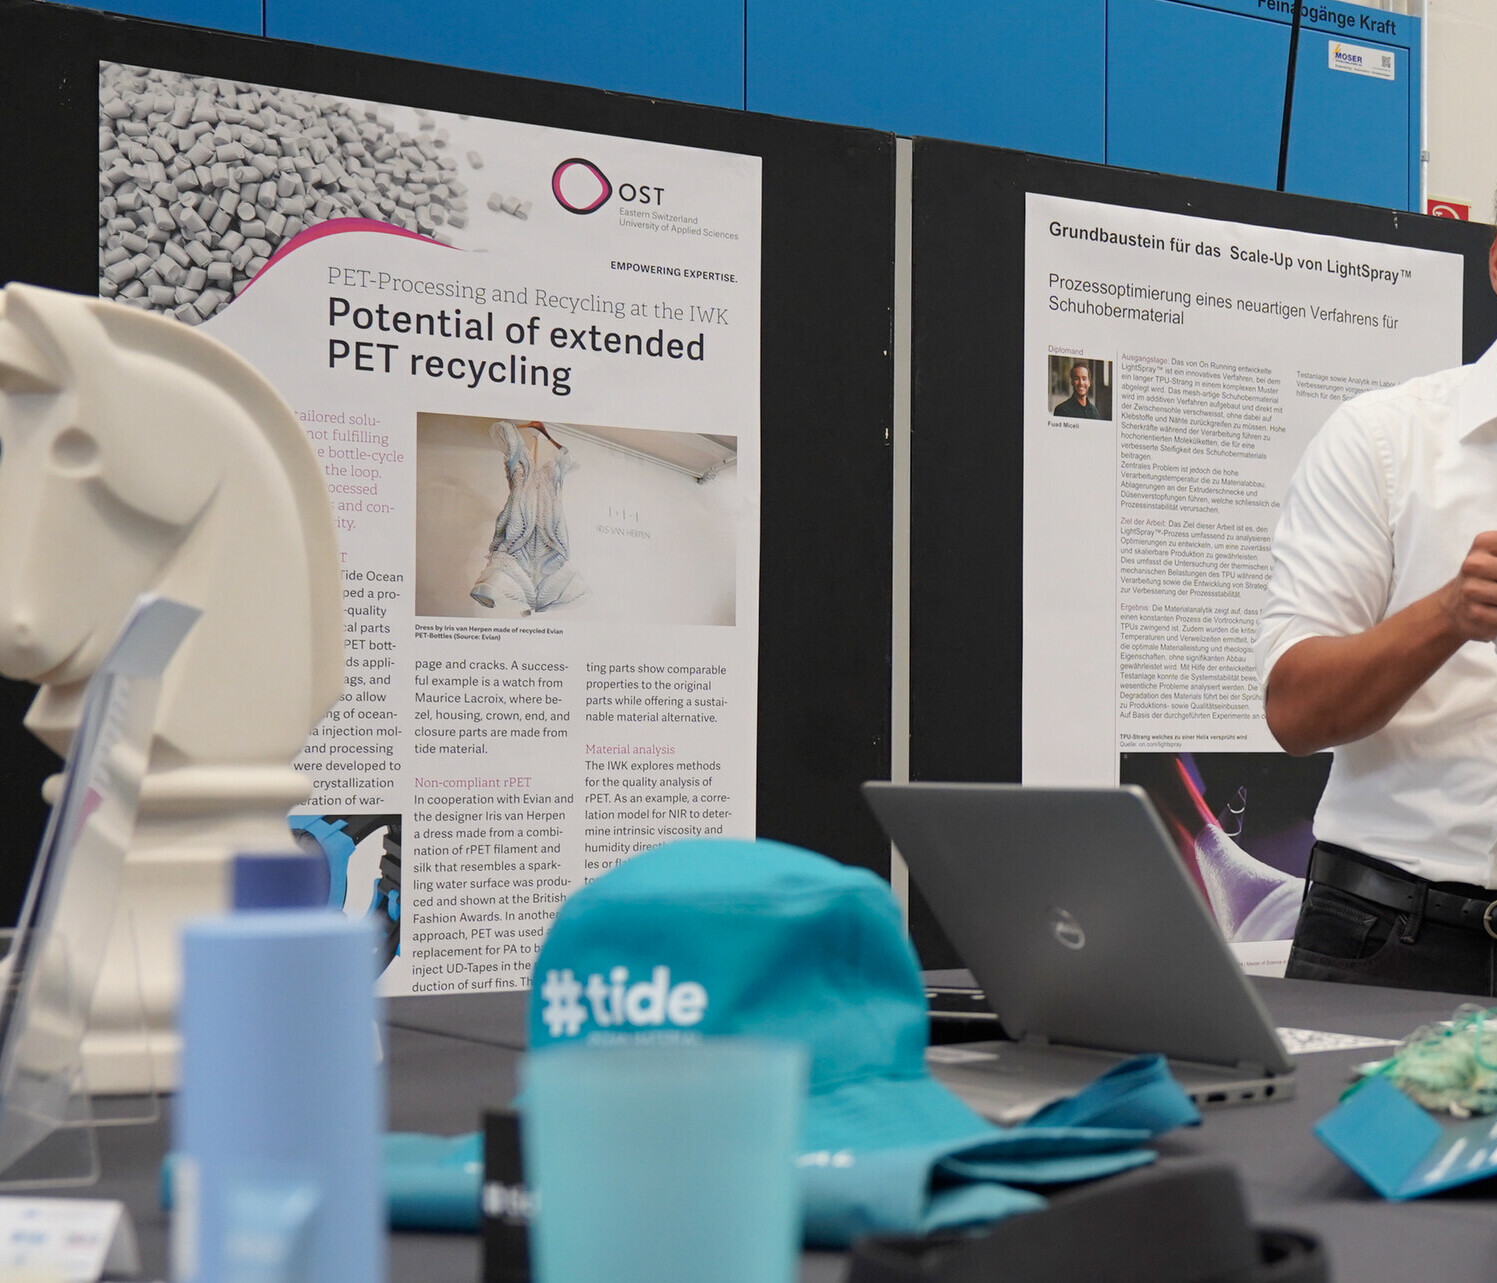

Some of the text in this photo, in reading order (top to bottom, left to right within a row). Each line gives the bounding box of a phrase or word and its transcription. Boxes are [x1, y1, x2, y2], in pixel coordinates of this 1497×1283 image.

[1360, 14, 1396, 35] Kraft
[1335, 52, 1363, 63] MOSER
[618, 183, 664, 206] OST
[619, 208, 698, 225] Eastern Switzerland
[619, 218, 739, 240] University of Applied Sciences
[1049, 221, 1164, 250] Grundbaustein
[1169, 237, 1191, 253] für
[1195, 241, 1221, 258] das
[1230, 245, 1293, 270] Scale-Up
[1297, 258, 1322, 271] von
[611, 260, 737, 283] EMPOWERING EXPERTISE.
[328, 266, 728, 325] PET-Processing and Recycling at the IWK
[1049, 273, 1398, 329] Prozessoptimierung eines neuartigen Verfahrens für
[1049, 295, 1184, 324] Schuhobermaterial
[328, 297, 705, 361] Potential of extended
[328, 338, 572, 396] PET recycling
[325, 465, 381, 481] the loop.
[415, 624, 434, 633] Dress
[434, 624, 443, 632] by
[455, 626, 468, 634] van
[468, 625, 492, 635] Herpen
[415, 659, 568, 671] page and cracks. A success-
[586, 662, 726, 676] ting parts show comparable
[415, 675, 563, 688] ful example is a watch from
[586, 679, 711, 693] properties to the original
[415, 692, 562, 704] Maurice Lacroix, where be-
[586, 695, 727, 708] parts while offering a sustai-
[414, 709, 570, 723] zel, housing, crown, end, and
[585, 711, 717, 722] nable material alternative.
[414, 726, 567, 739] closure parts are made from
[414, 743, 487, 754] tide material.
[585, 744, 675, 757] Material analysis
[293, 760, 401, 773] were developed to
[585, 760, 721, 772] The IWK explores methods
[415, 777, 532, 790] Non-compliant rPET
[414, 793, 574, 806] In cooperation with Evian and
[414, 810, 565, 824] the designer Iris van Herpen
[541, 965, 708, 1036] #tide
